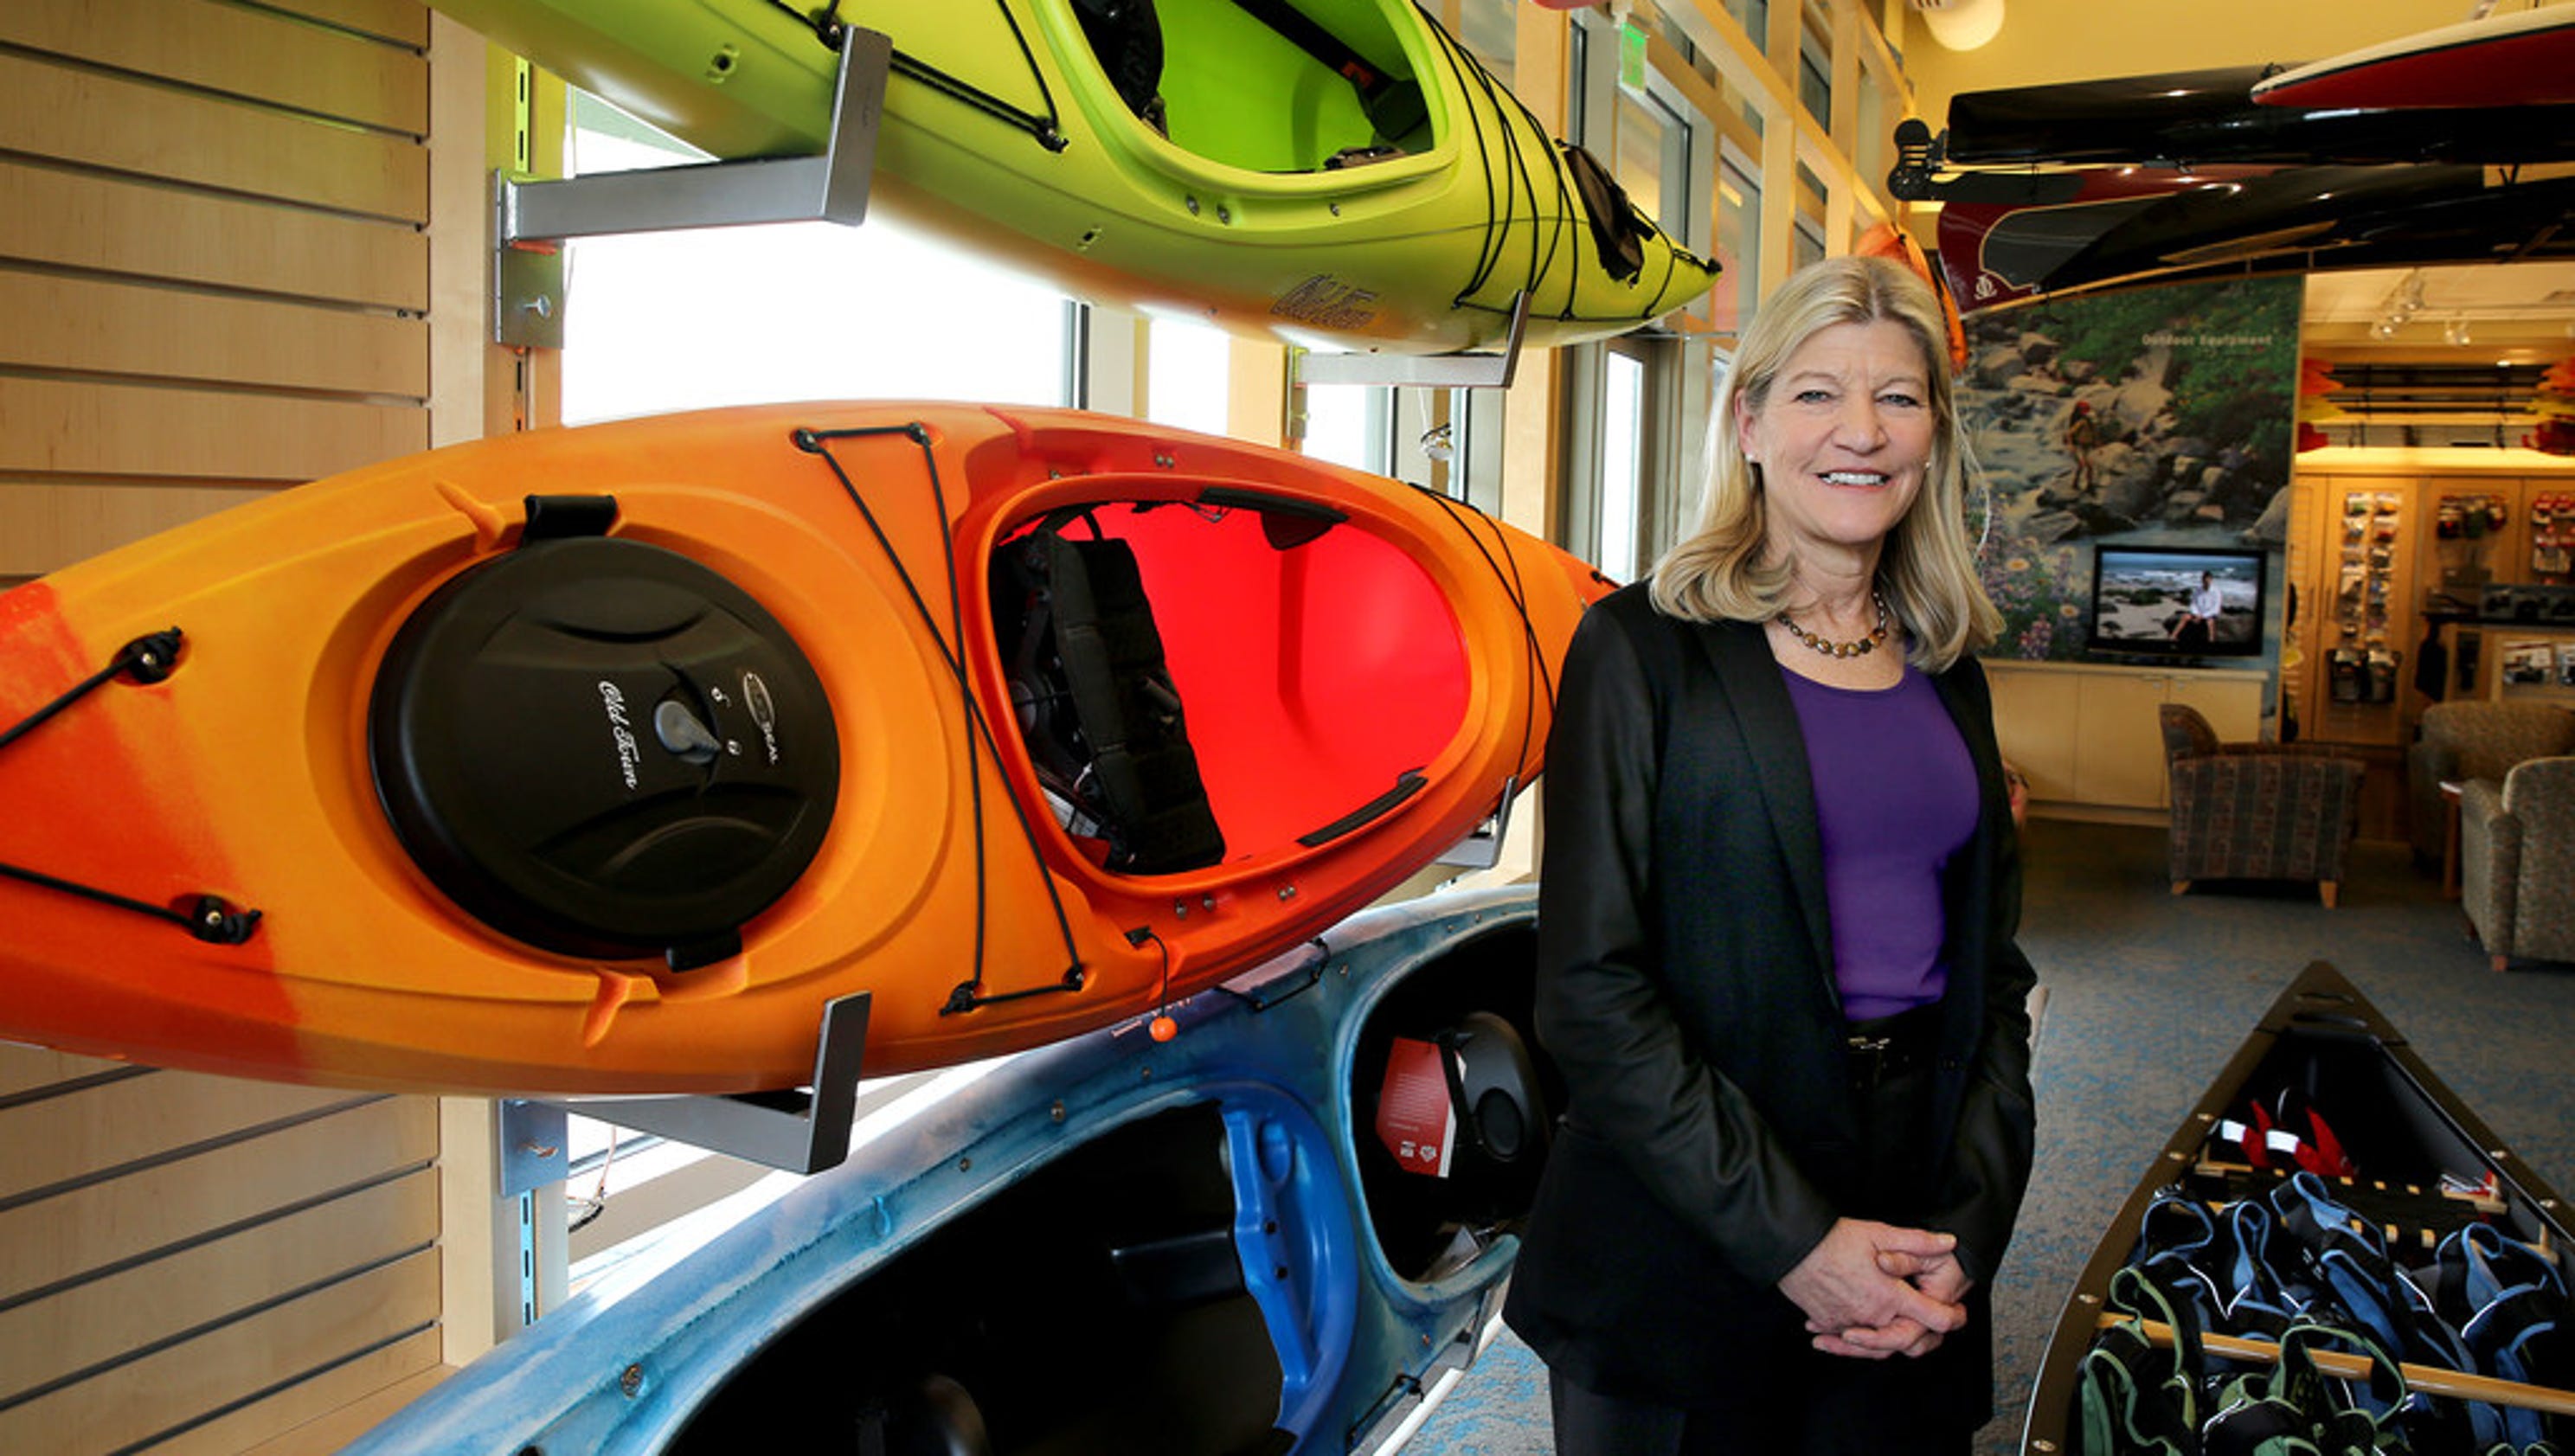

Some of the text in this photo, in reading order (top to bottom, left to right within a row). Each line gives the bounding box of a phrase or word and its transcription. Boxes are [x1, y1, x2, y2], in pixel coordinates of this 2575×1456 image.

[2142, 333, 2272, 347] Outdoor Equipment
[598, 680, 640, 791] Old Town
